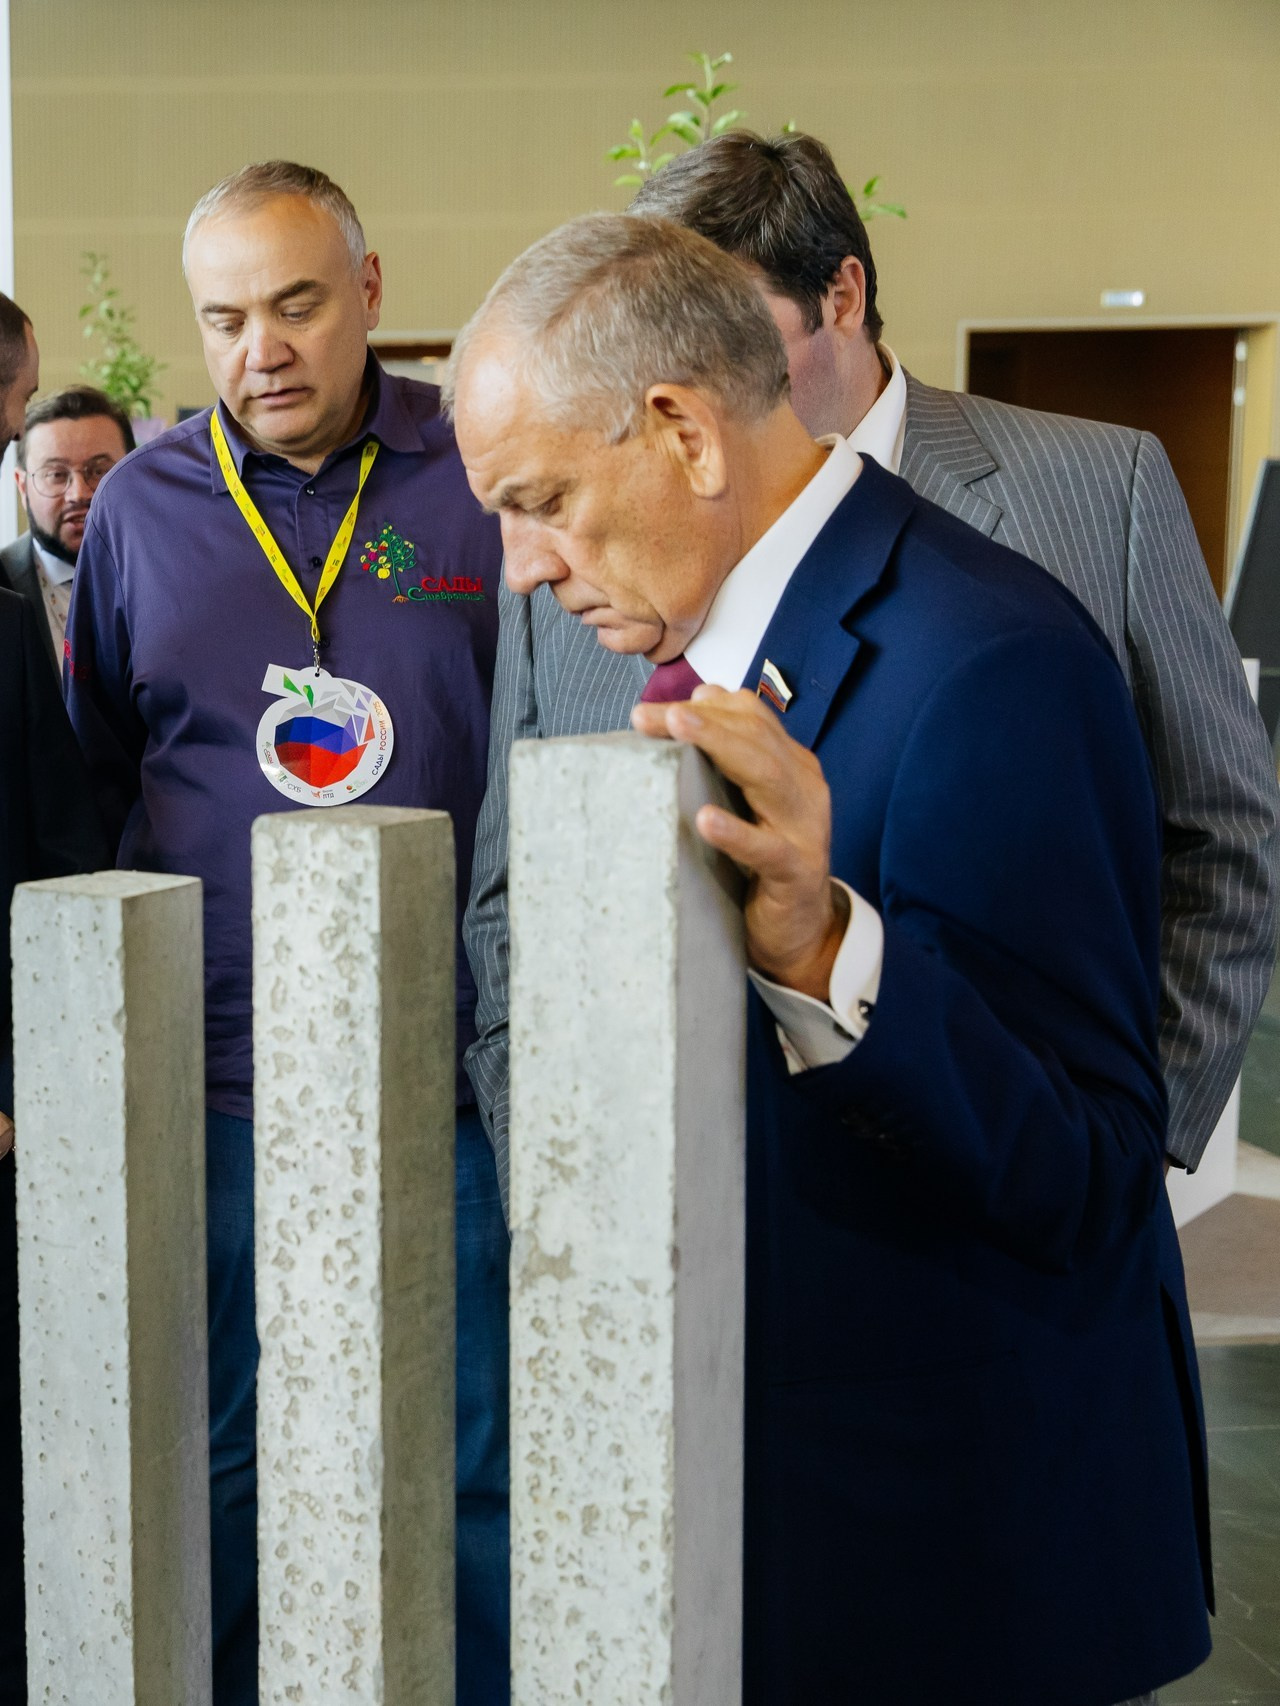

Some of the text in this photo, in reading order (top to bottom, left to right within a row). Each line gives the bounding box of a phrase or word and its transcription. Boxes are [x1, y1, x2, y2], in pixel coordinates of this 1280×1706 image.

[421, 576, 483, 592] САДЫ
[373, 702, 384, 717] 2025
[372, 754, 384, 776] САДЫ
